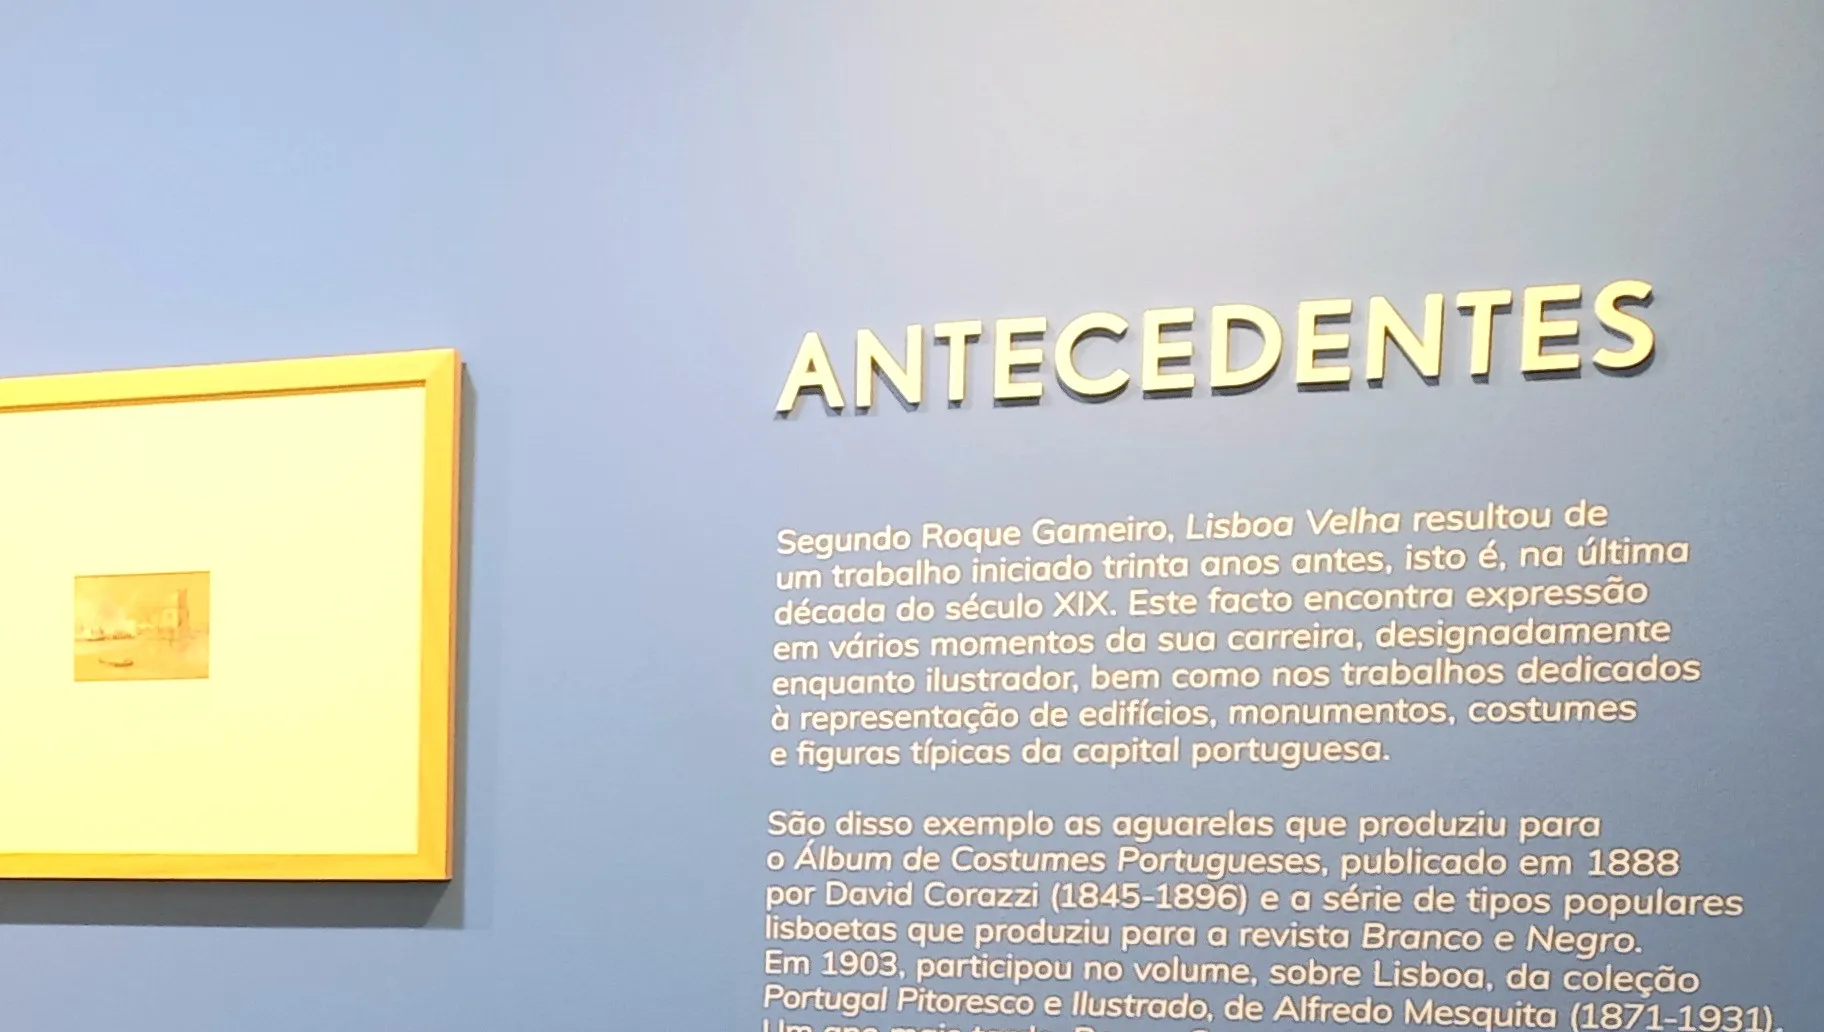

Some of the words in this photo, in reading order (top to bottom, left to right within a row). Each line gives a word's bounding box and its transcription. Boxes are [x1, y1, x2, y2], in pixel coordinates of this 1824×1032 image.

[776, 279, 1657, 413] ANTECEDENTES
[777, 524, 911, 560] Segundo
[922, 523, 1021, 554] Roque
[1032, 515, 1174, 545] Gameiro,
[1186, 511, 1294, 539] Lisboa
[1306, 506, 1400, 535] Velha
[1413, 502, 1551, 532] resultou
[1564, 499, 1608, 527] de
[776, 569, 821, 590] um
[831, 559, 961, 588] trabalho
[972, 554, 1092, 583] iniciado
[1102, 552, 1188, 579] trinta
[1200, 555, 1280, 576] anos
[1291, 548, 1392, 575] antes,
[1405, 544, 1466, 570] isto
[1478, 539, 1506, 571] é,
[1520, 546, 1563, 567] na
[1577, 536, 1689, 566] última
[774, 597, 885, 625] década
[896, 596, 935, 622] do
[946, 592, 1043, 620] século
[1053, 590, 1117, 617] XIX.
[1129, 589, 1197, 616] Este
[1208, 586, 1292, 613] facto
[1304, 584, 1453, 611] encontra
[1466, 574, 1648, 613] expressão
[773, 640, 818, 661] em
[828, 632, 920, 659] vários
[930, 631, 1094, 656] momentos
[1105, 626, 1146, 653] da
[1158, 631, 1215, 652] sua
[1227, 622, 1363, 651] carreira,
[1375, 617, 1671, 654] designadamente
[772, 670, 915, 701] enquanto
[926, 665, 1078, 693] ilustrador,
[1091, 664, 1159, 690] bem
[1172, 667, 1260, 688] como
[1272, 666, 1330, 687] nos
[1341, 657, 1504, 686] trabalhos
[1517, 653, 1701, 684] dedicados
[771, 704, 789, 731] à
[800, 701, 1019, 736] representação
[1029, 701, 1068, 727] de
[1078, 698, 1217, 729] edifícios,
[1229, 698, 1456, 726] monumentos,
[1468, 697, 1637, 723] costumes
[770, 747, 787, 766] e
[796, 740, 900, 772] figuras
[910, 737, 1011, 771] típicas
[1021, 737, 1062, 763] da
[1073, 736, 1180, 769] capital
[1192, 738, 1390, 769] portuguesa.
[768, 810, 825, 836] São
[835, 810, 913, 836] disso
[923, 810, 1054, 842] exemplo
[1064, 816, 1101, 836] as
[1112, 809, 1274, 843] aguarelas
[1285, 816, 1347, 843] que
[1359, 809, 1506, 843] produziu
[1519, 816, 1600, 844] para
[766, 851, 785, 870] o
[793, 838, 892, 871] Álbum
[902, 845, 941, 871] de
[951, 845, 1106, 872] Costumes
[1117, 846, 1328, 880] Portugueses,
[1341, 847, 1507, 881] publicado
[1519, 855, 1572, 875] em
[1588, 848, 1680, 876] 1888
[766, 886, 816, 911] por
[825, 880, 913, 906] David
[924, 881, 1039, 907] Corazzi
[1051, 882, 1247, 915] (1845-1896)
[1260, 890, 1279, 910] e
[1290, 890, 1311, 911] a
[1322, 883, 1402, 912] série
[1413, 885, 1455, 912] de
[1465, 886, 1551, 920] tipos
[1564, 887, 1744, 921] populares
[765, 914, 897, 941] lisboetas
[907, 922, 964, 948] que
[975, 918, 1110, 949] produziu
[1121, 925, 1195, 952] para
[1207, 927, 1227, 947] a
[1240, 921, 1349, 949] revista
[1361, 922, 1482, 951] Branco
[1494, 931, 1515, 951] e
[1526, 924, 1642, 960] Negro.
[765, 949, 810, 975] Em
[822, 950, 905, 979] 1903,
[916, 953, 1072, 985] participou
[1084, 961, 1123, 981] no
[1133, 955, 1258, 987] volume,
[1269, 958, 1361, 986] sobre
[1373, 959, 1493, 992] Lisboa,
[1506, 962, 1550, 990] da
[1563, 963, 1700, 999] coleção
[764, 984, 888, 1017] Portugal
[897, 987, 1034, 1015] Pitoresco
[1044, 996, 1062, 1016] e
[1072, 990, 1213, 1022] Ilustrado,
[1224, 993, 1263, 1021] de
[1273, 995, 1393, 1024] Alfredo
[1404, 998, 1557, 1032] Mesquita
